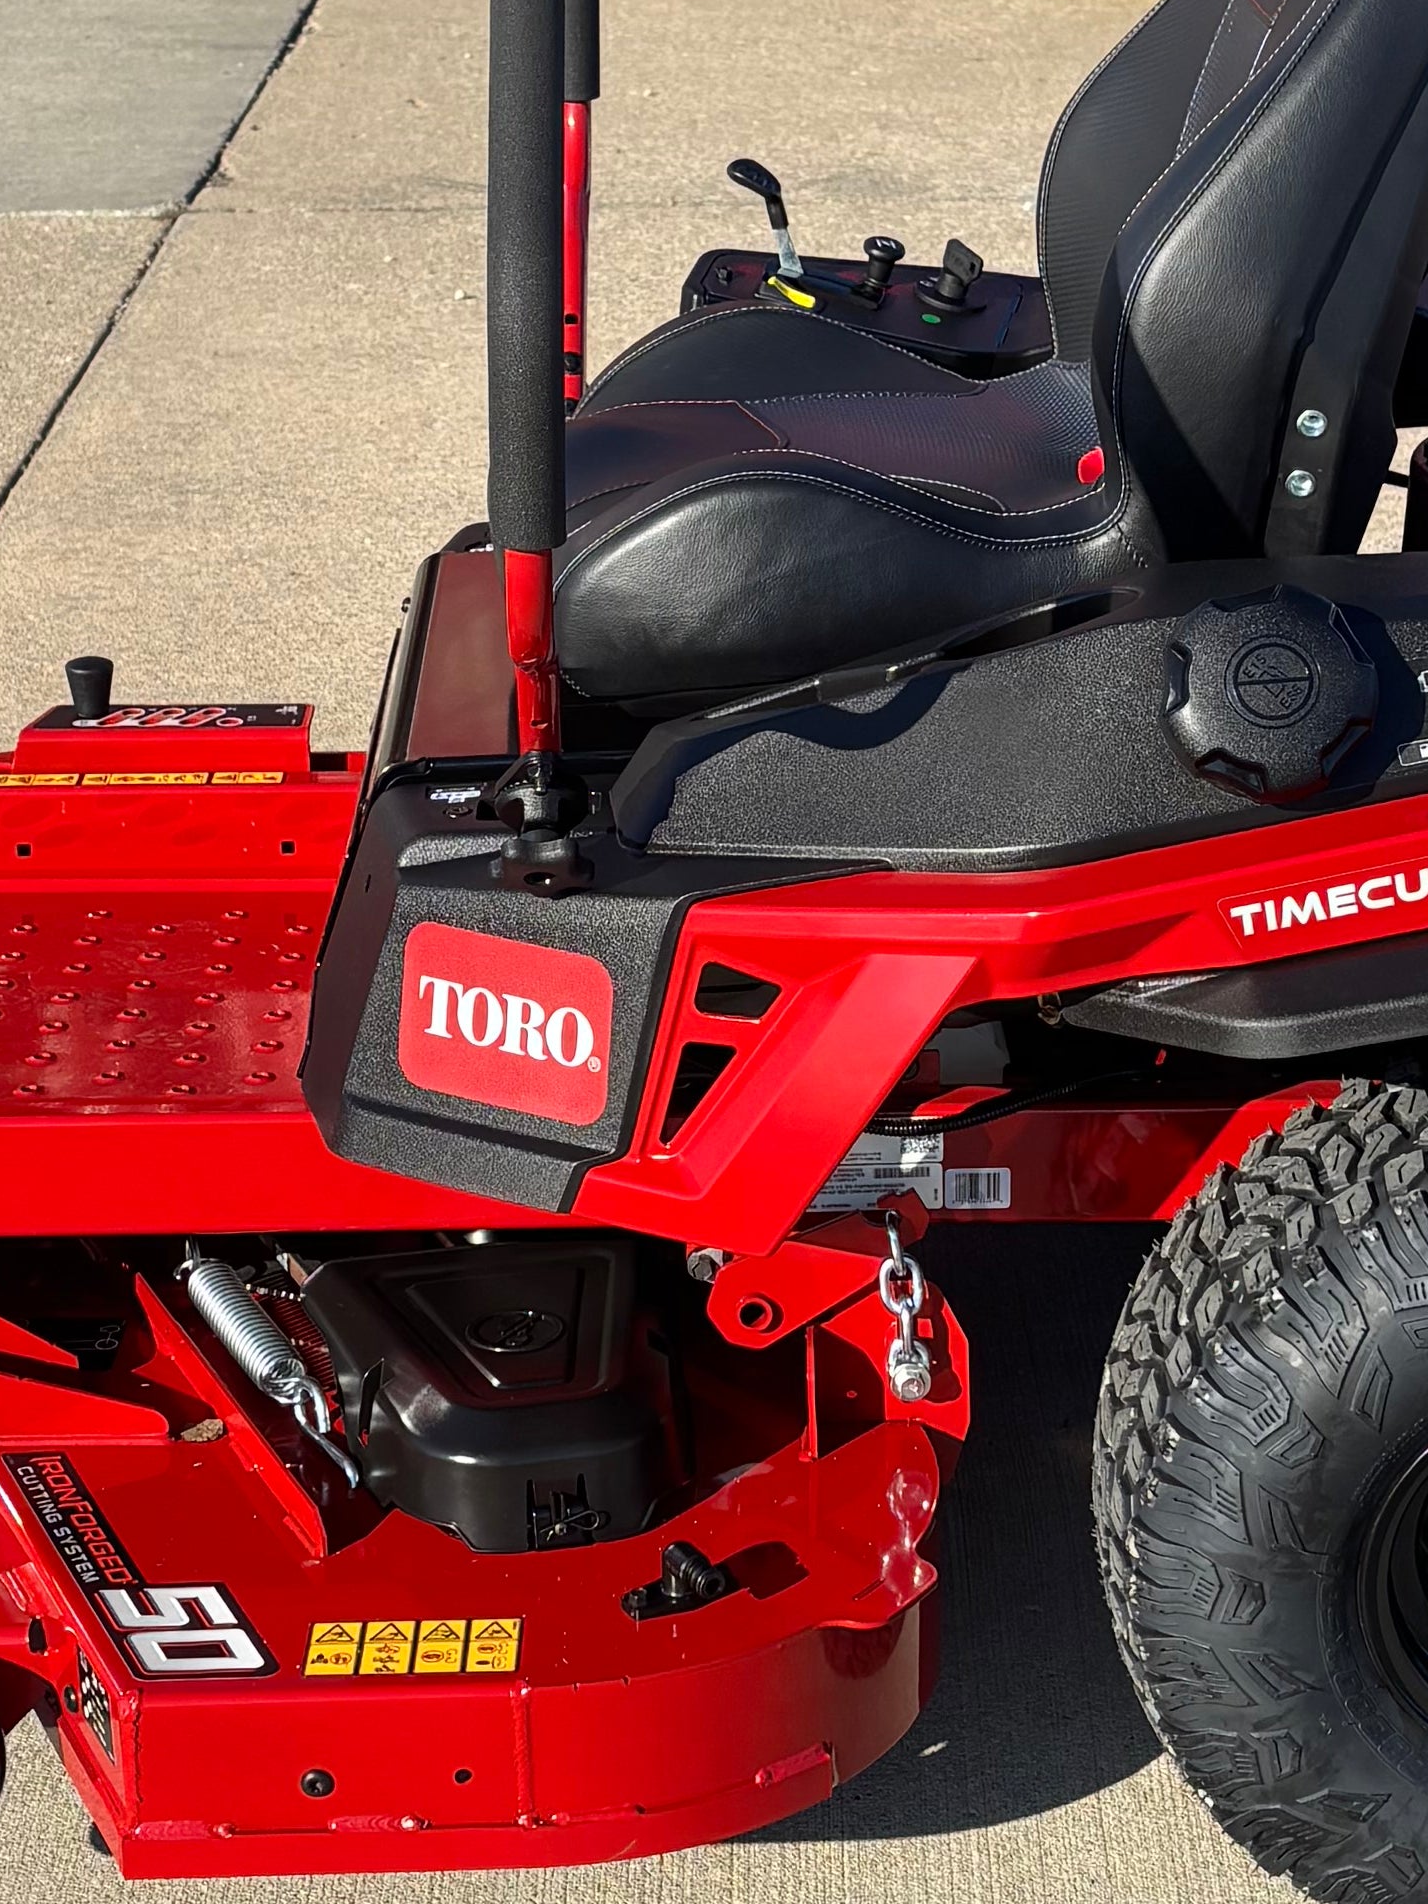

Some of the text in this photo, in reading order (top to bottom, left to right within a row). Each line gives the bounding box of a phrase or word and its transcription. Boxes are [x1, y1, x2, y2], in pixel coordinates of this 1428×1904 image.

[17, 1466, 99, 1583] CUTTING SYSTEM
[94, 1586, 266, 1674] 50
